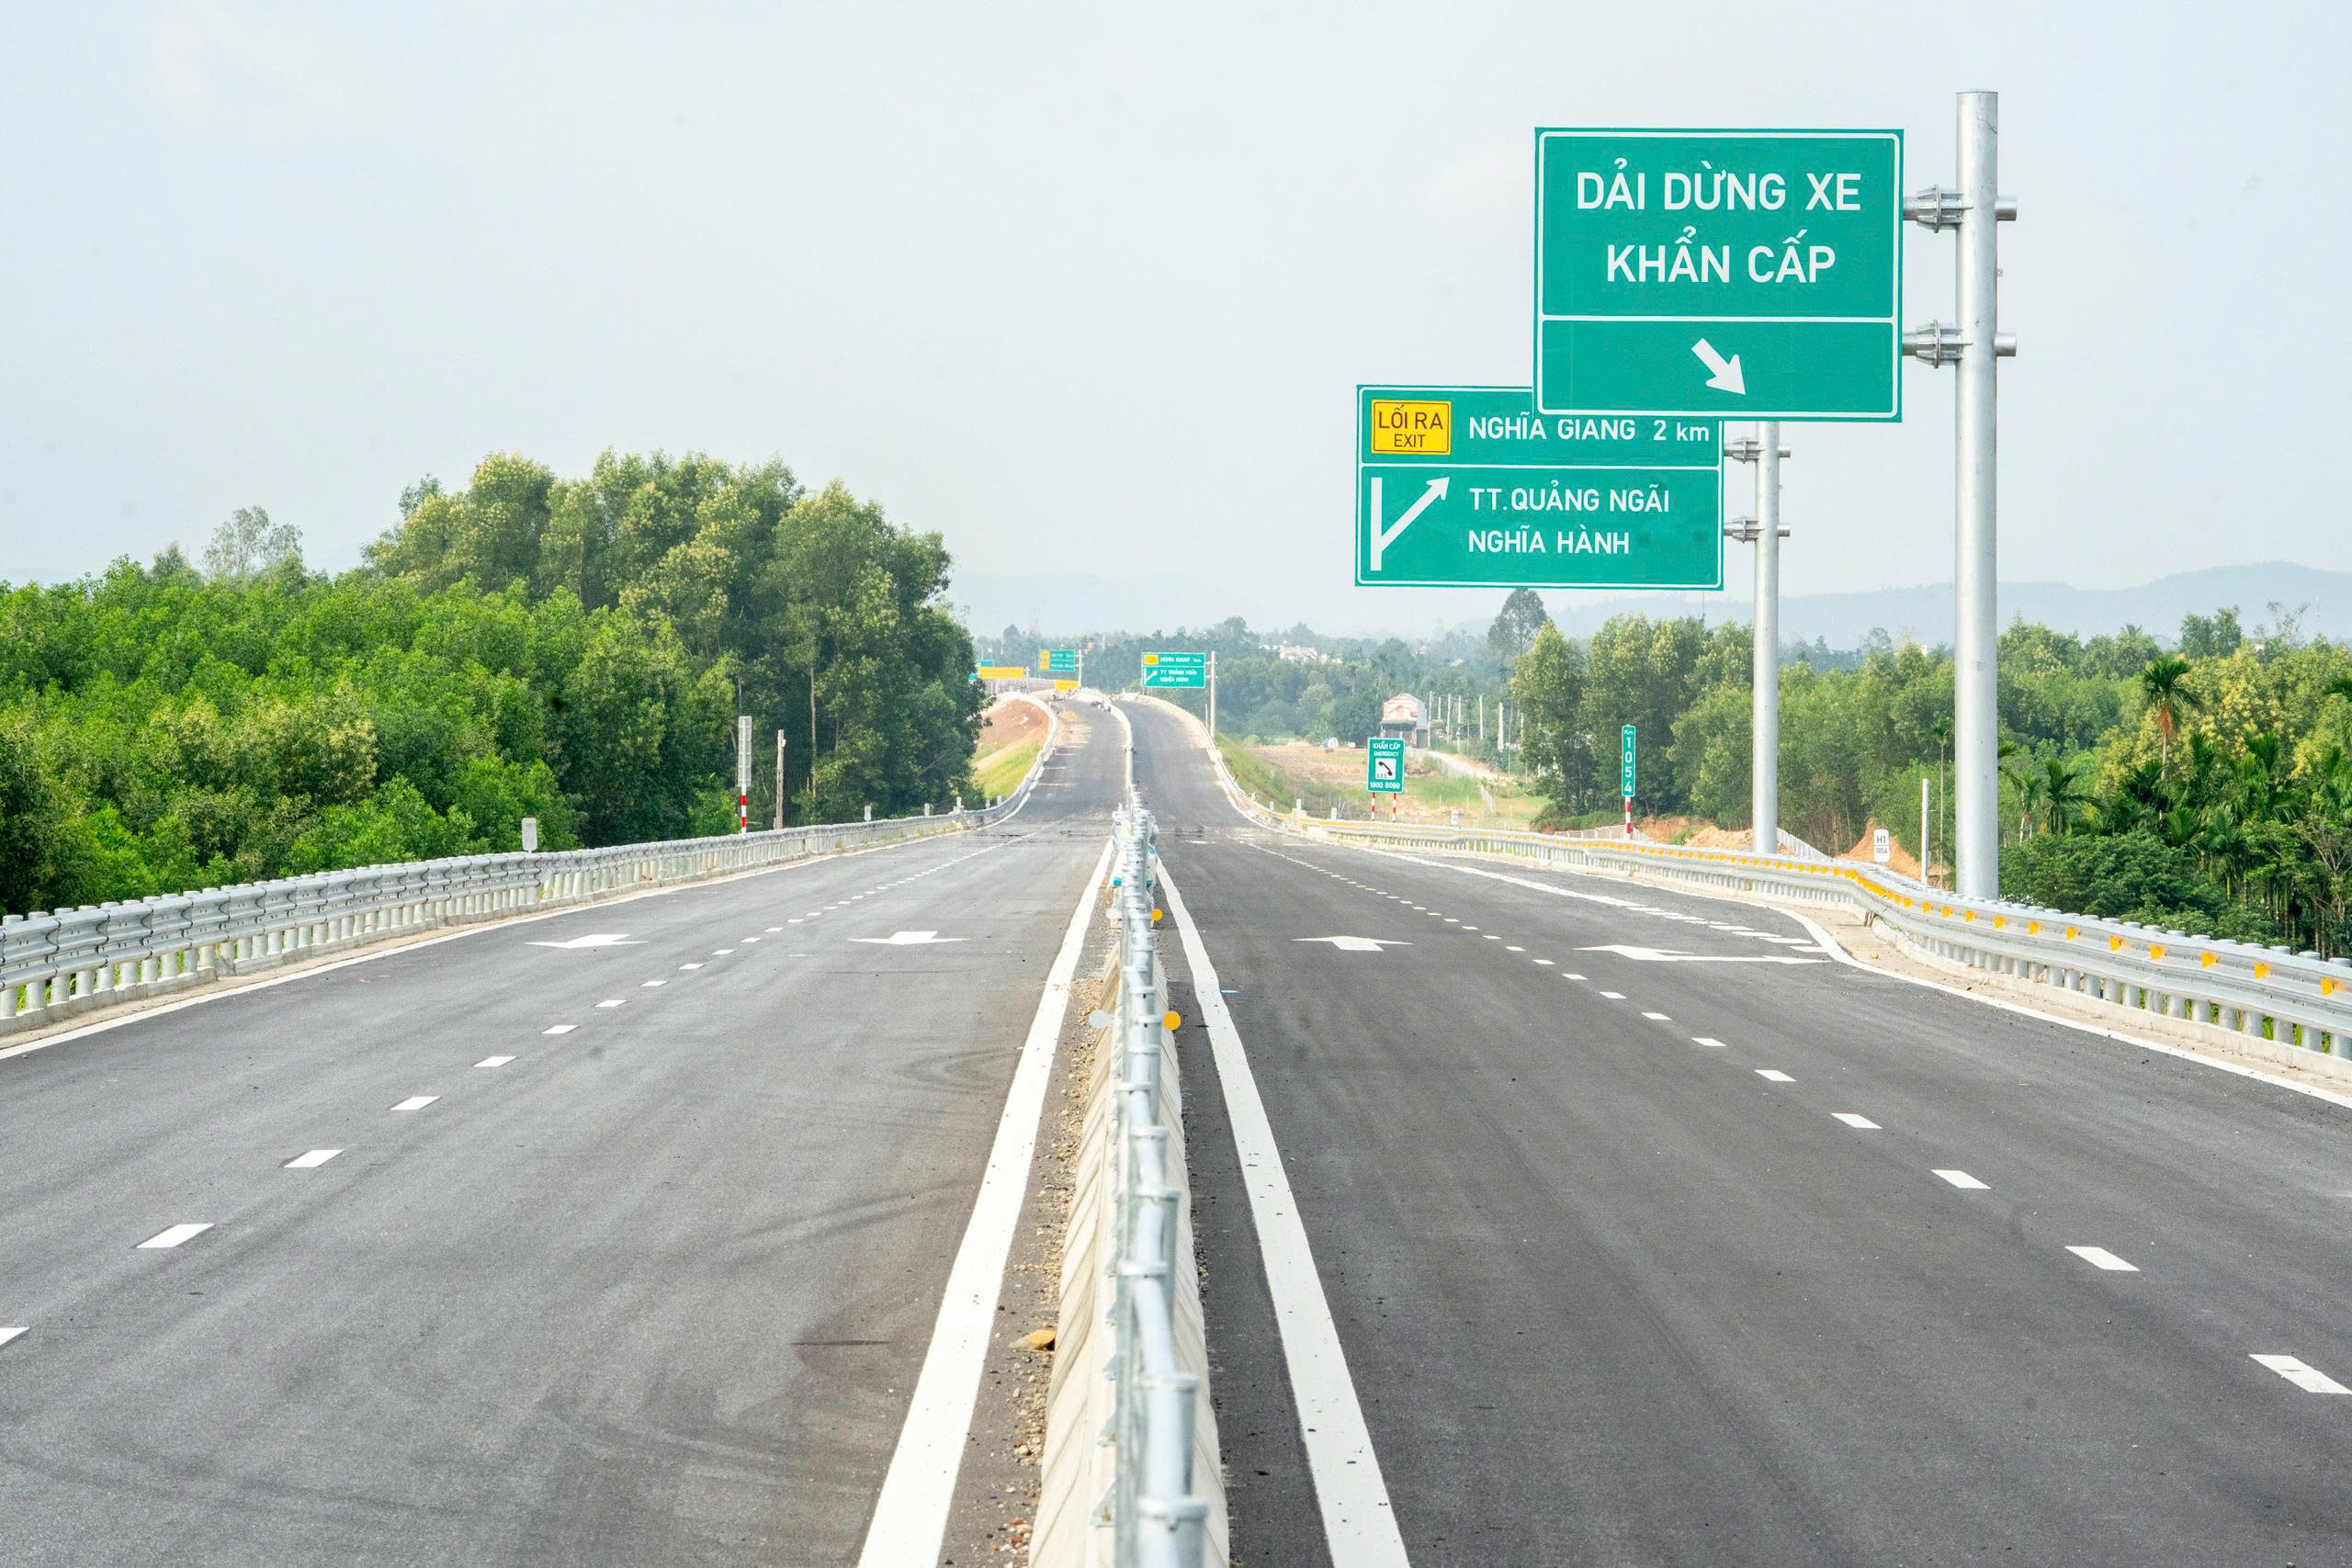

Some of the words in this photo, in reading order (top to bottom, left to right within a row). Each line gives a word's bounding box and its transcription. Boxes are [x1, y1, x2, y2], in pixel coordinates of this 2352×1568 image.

[1577, 157, 1645, 210] DẢI
[1664, 160, 1786, 211] DỪNG
[1805, 173, 1861, 211] XE
[1607, 225, 1731, 283] KHẨN
[1747, 229, 1836, 284] CẤP
[1378, 404, 1408, 430] LỐI
[1415, 412, 1443, 430] RA
[1469, 411, 1547, 441] NGHĨA
[1557, 418, 1636, 441] GIANG
[1653, 419, 1667, 441] 2
[1676, 423, 1710, 442] km
[1394, 433, 1427, 448] EXIT
[1609, 483, 1669, 513] NGÃI
[1468, 525, 1547, 553] NGHĨA
[1557, 524, 1630, 555] HÀNH
